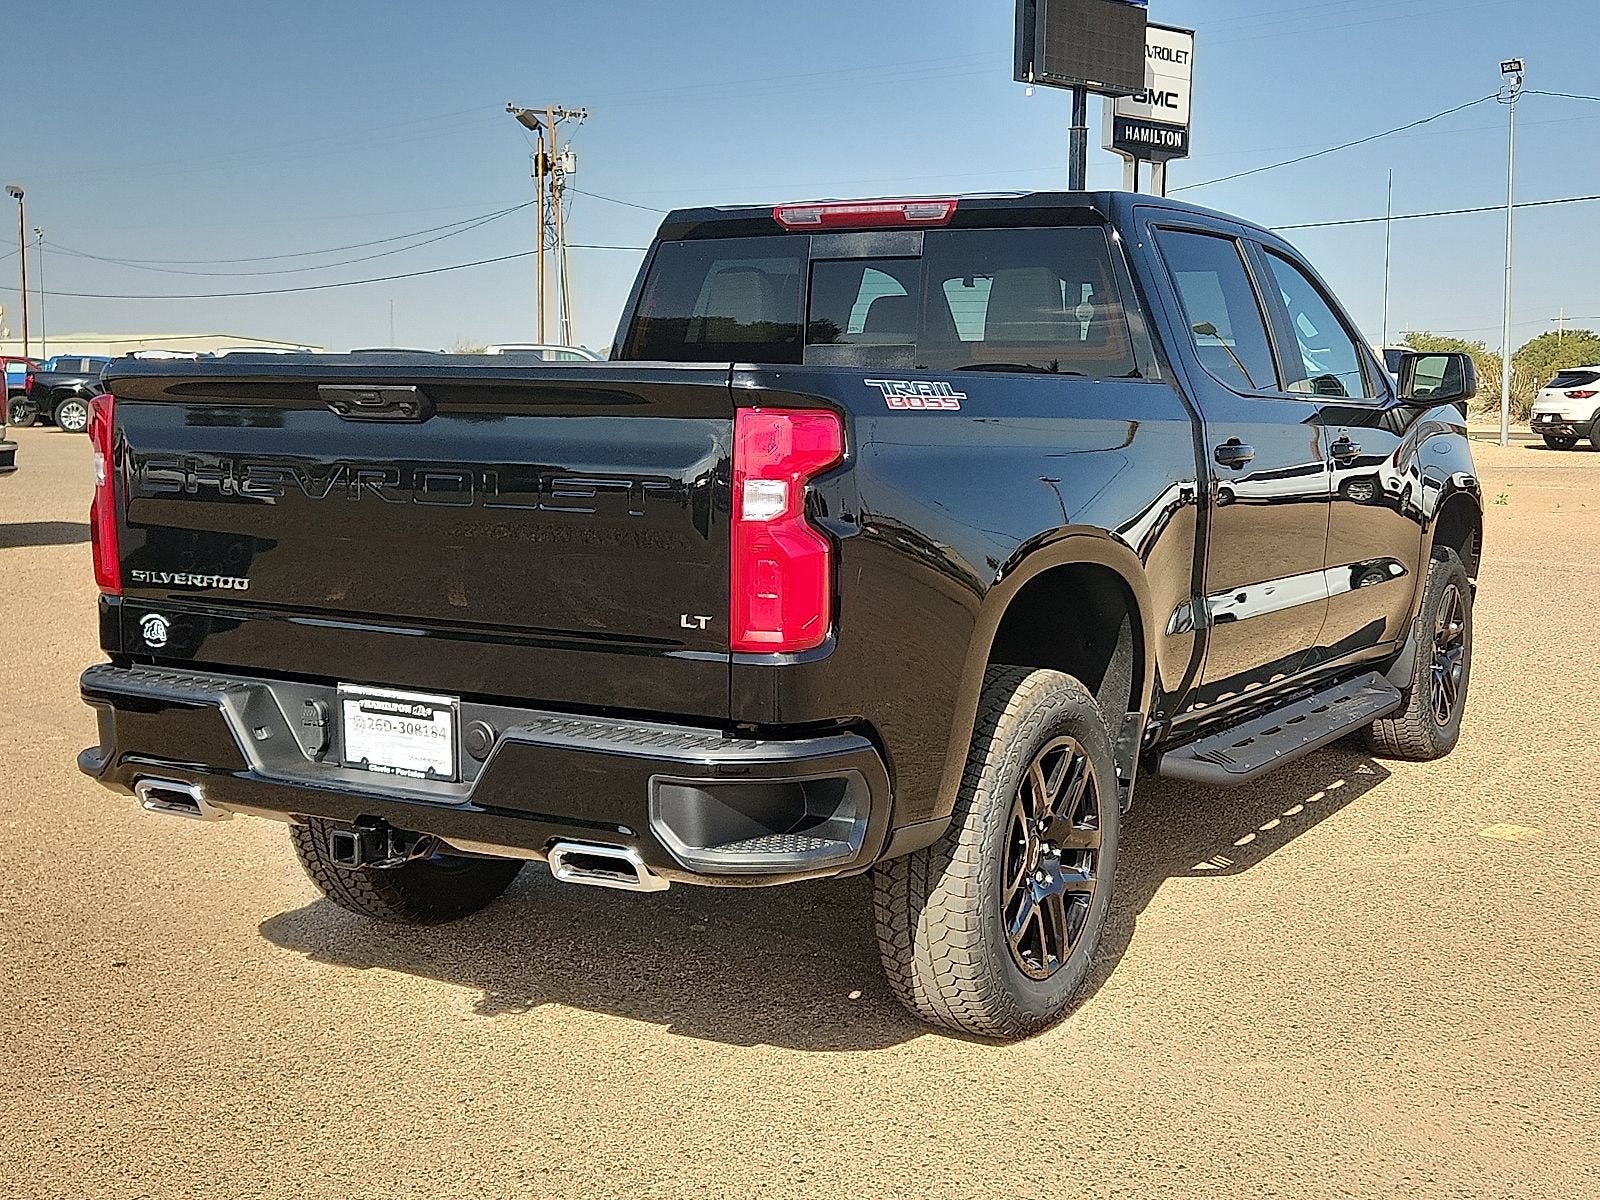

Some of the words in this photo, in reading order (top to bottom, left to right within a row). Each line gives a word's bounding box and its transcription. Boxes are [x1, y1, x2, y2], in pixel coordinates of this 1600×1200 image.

[1144, 45, 1189, 64] VROLET
[1125, 125, 1182, 147] HAMILTON
[863, 378, 968, 399] TRAIL
[886, 395, 961, 411] BOSS
[140, 456, 672, 517] CHEVROLET
[131, 569, 250, 591] SILVERADO
[680, 613, 714, 630] LT
